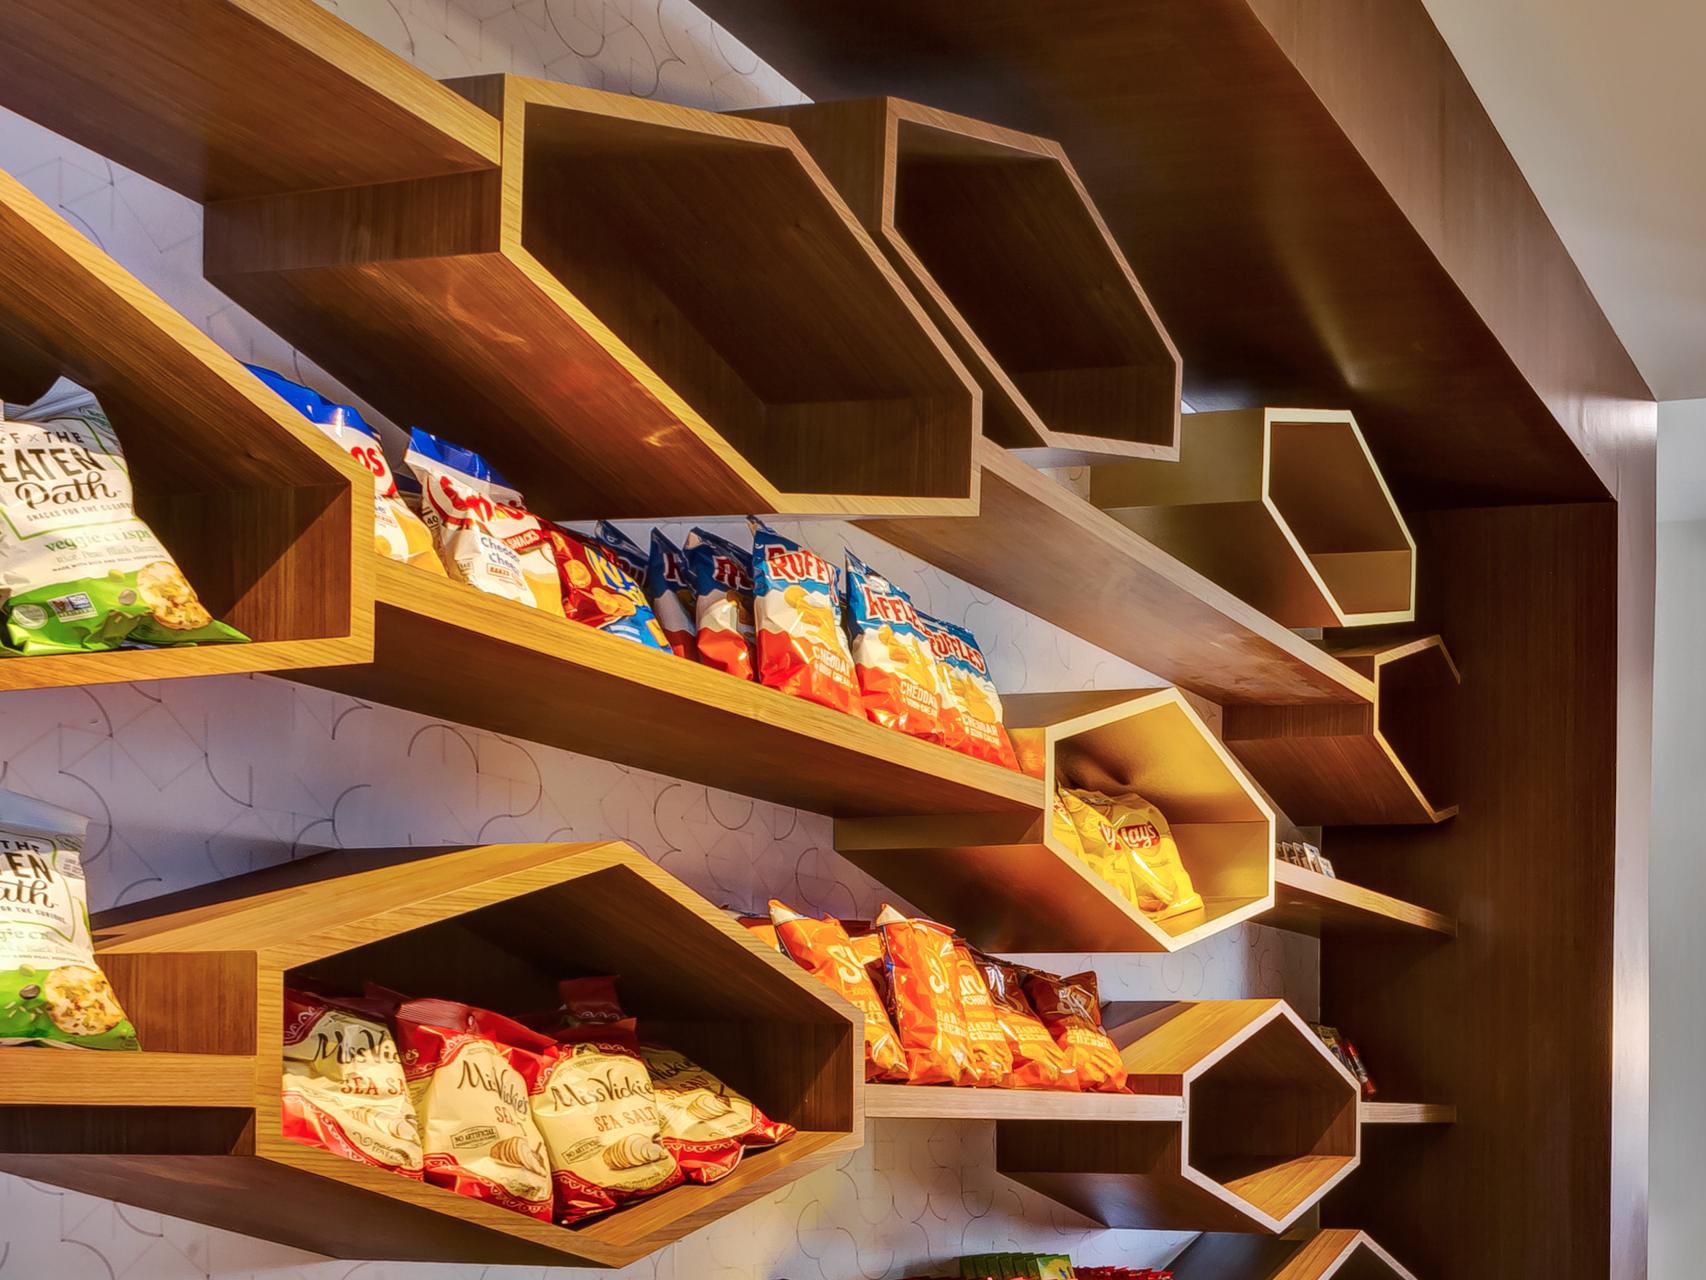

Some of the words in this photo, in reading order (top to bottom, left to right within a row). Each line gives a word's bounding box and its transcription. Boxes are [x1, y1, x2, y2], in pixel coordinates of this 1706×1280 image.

[44, 431, 84, 443] THE
[15, 471, 117, 510] Path
[550, 1083, 606, 1111] Miss
[594, 1114, 623, 1132] SEA
[622, 1107, 657, 1125] SALT
